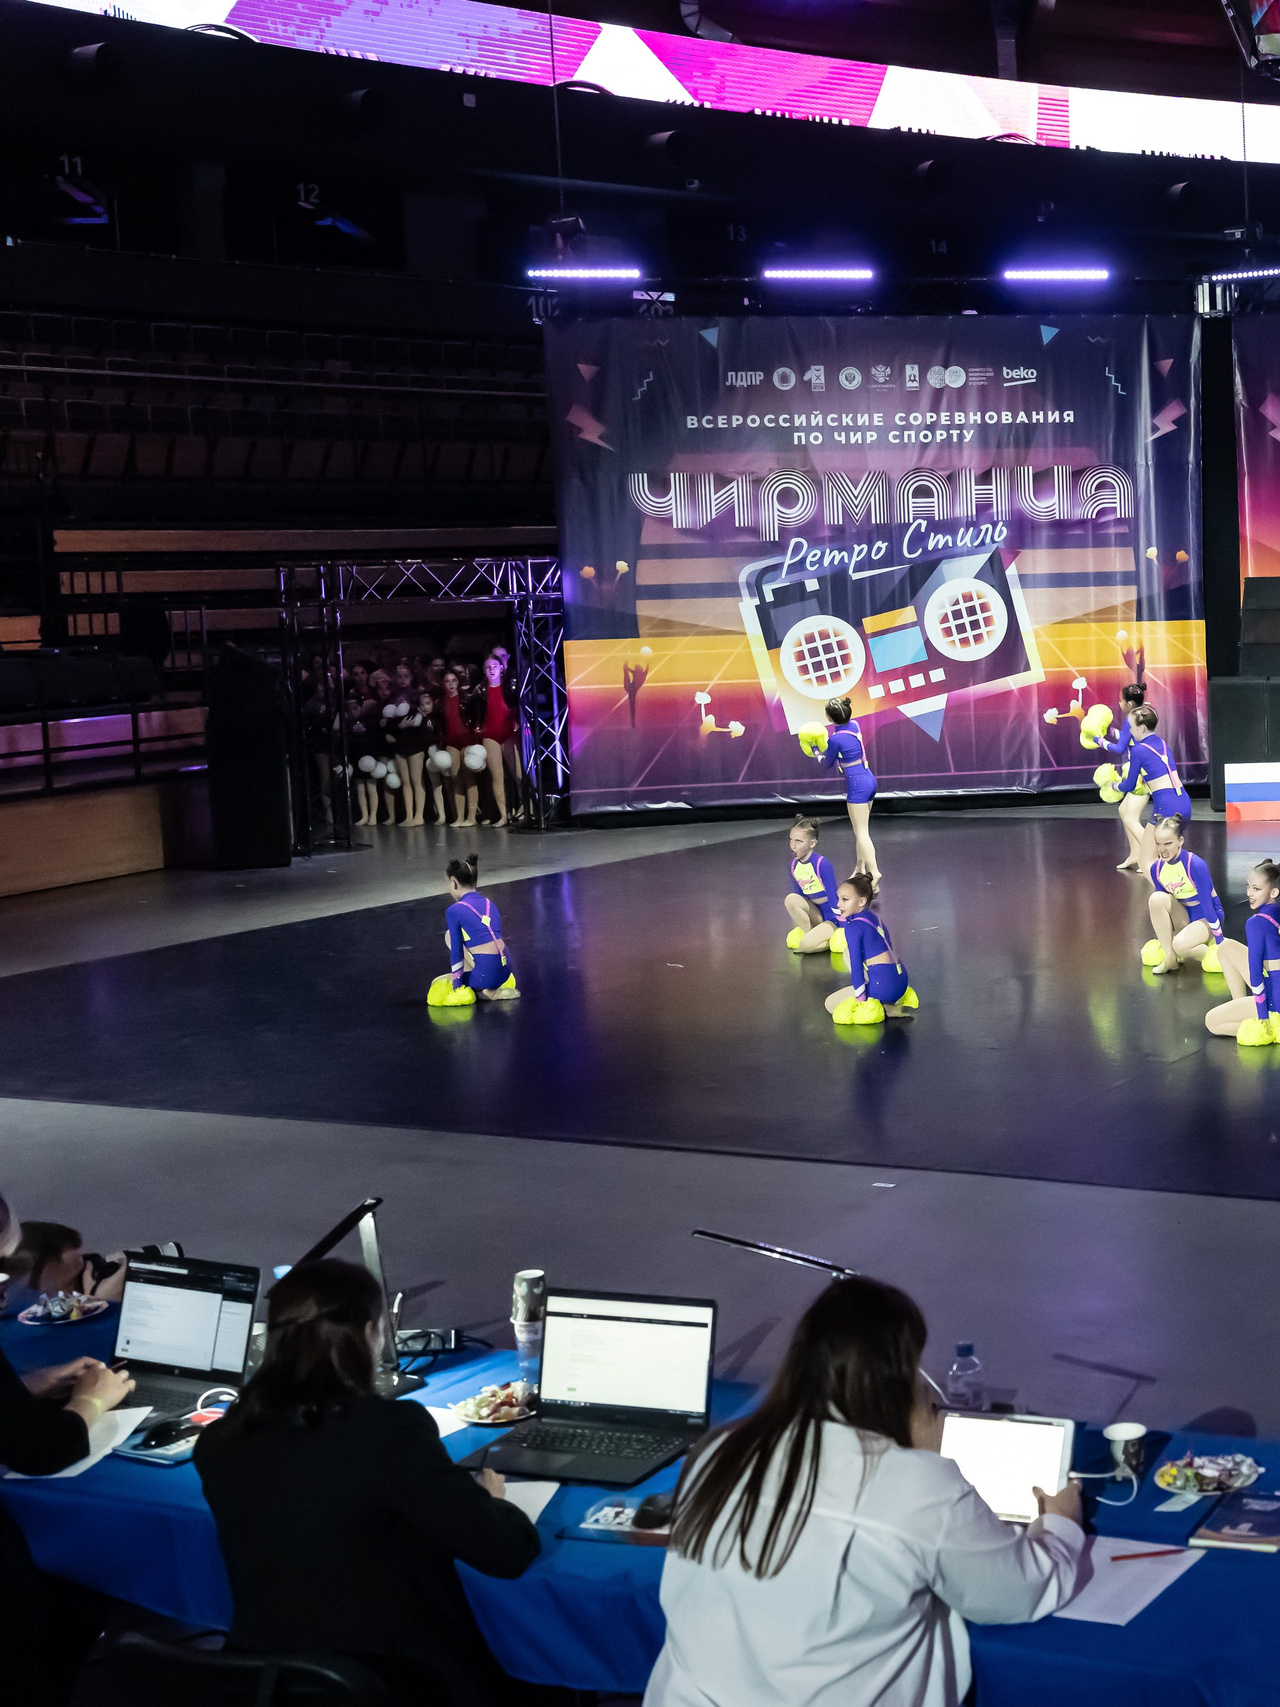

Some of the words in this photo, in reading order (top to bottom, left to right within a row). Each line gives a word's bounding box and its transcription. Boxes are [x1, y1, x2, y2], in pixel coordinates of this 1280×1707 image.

[296, 182, 320, 203] 12
[726, 371, 764, 387] ЛДПР
[1003, 366, 1037, 379] beko
[686, 411, 884, 429] ВСЕРОССИЙСКИЕ
[894, 410, 1075, 426] СОРЕВНОВАНИЯ
[793, 431, 824, 445] ПО
[833, 430, 878, 444] ЧИР
[888, 429, 975, 444] СПОРТУ
[781, 537, 887, 579] Ретро
[902, 519, 1008, 560] Стиль
